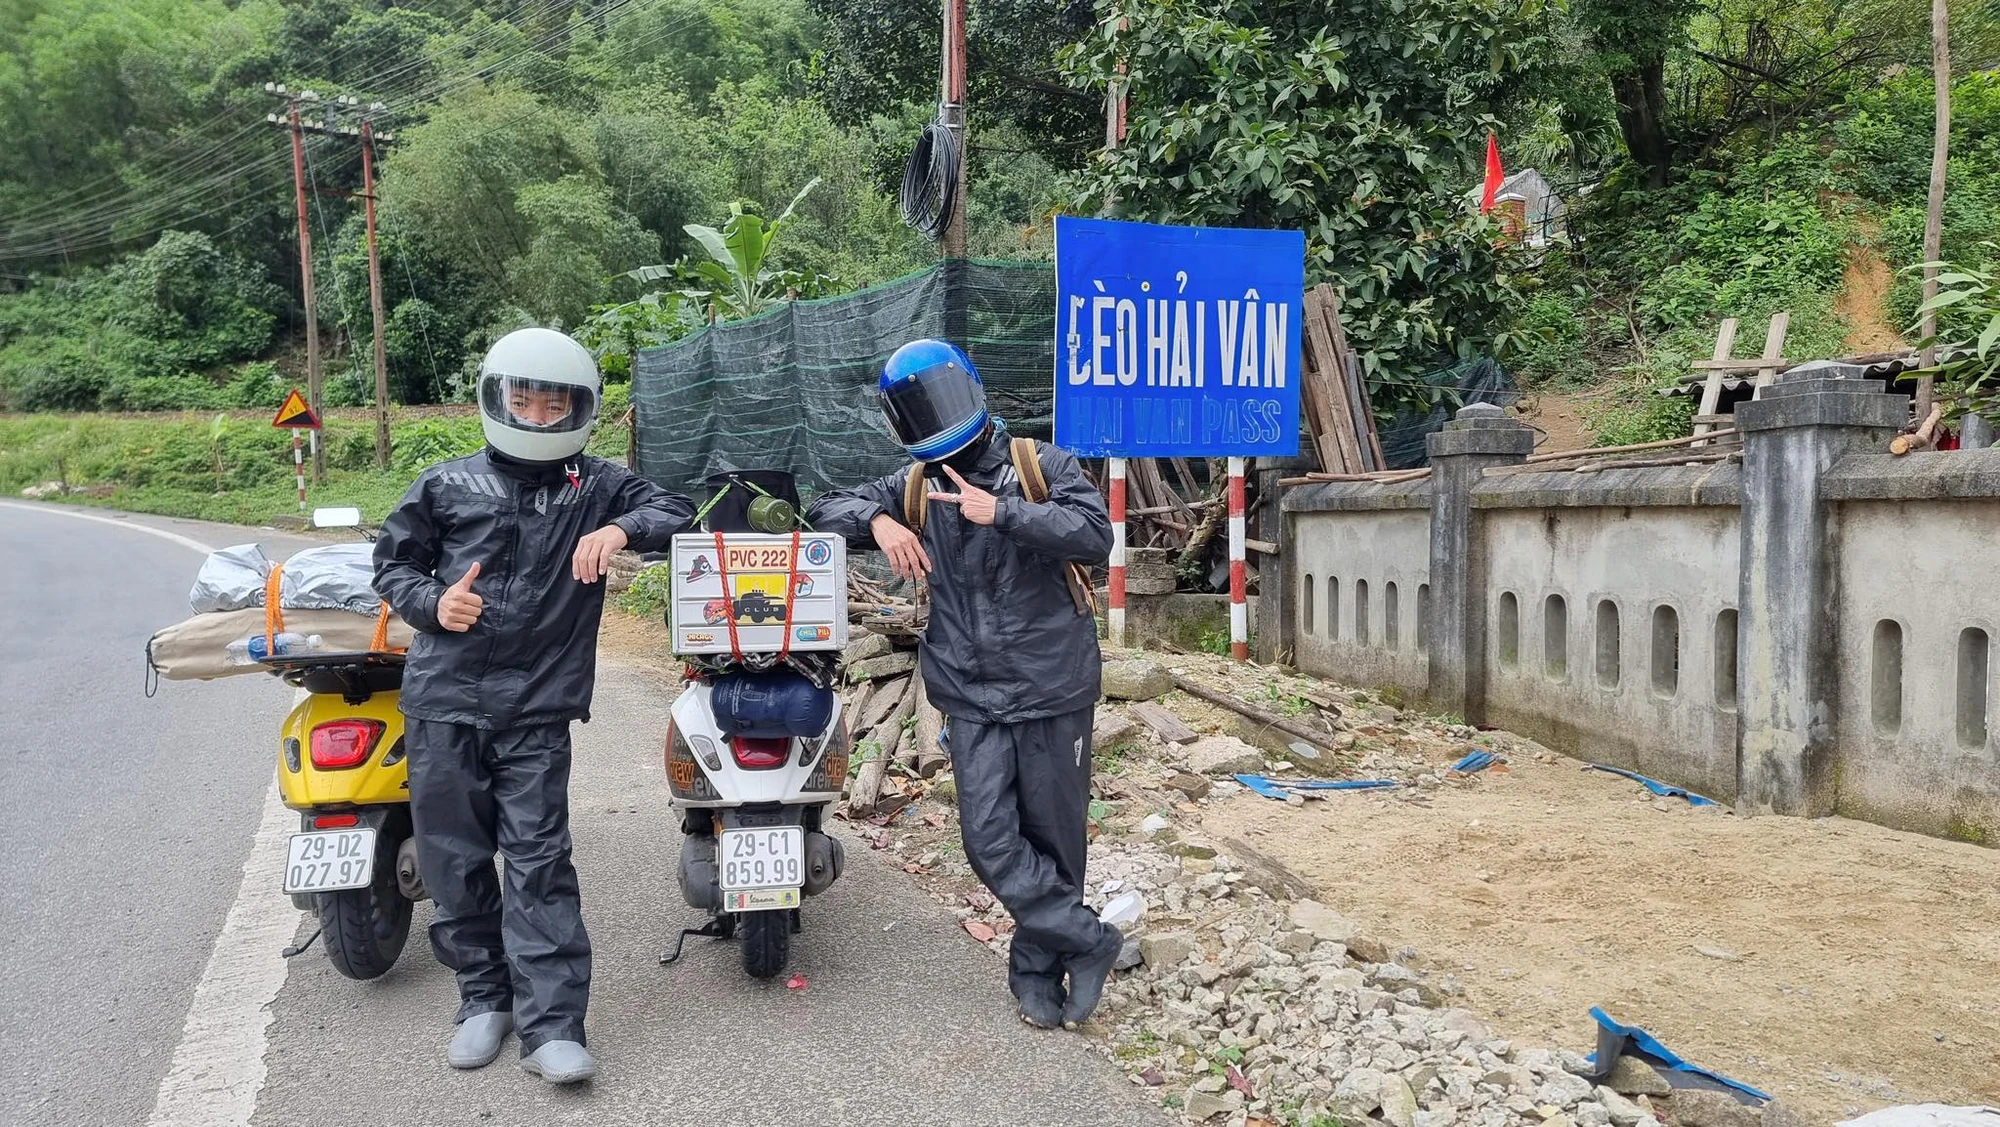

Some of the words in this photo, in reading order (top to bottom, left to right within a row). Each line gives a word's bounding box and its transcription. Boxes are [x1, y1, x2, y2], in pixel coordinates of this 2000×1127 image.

[1147, 270, 1205, 388] HẢI
[1217, 288, 1288, 388] VÂN
[1069, 397, 1123, 444] HAI
[1133, 398, 1192, 444] VAN
[1202, 398, 1282, 444] PASS
[730, 549, 757, 567] PVC
[761, 549, 788, 567] 222
[300, 833, 362, 860] 29-D2
[733, 831, 789, 857] 29-C1
[289, 859, 367, 888] 027.97
[726, 858, 798, 886] 859.99
